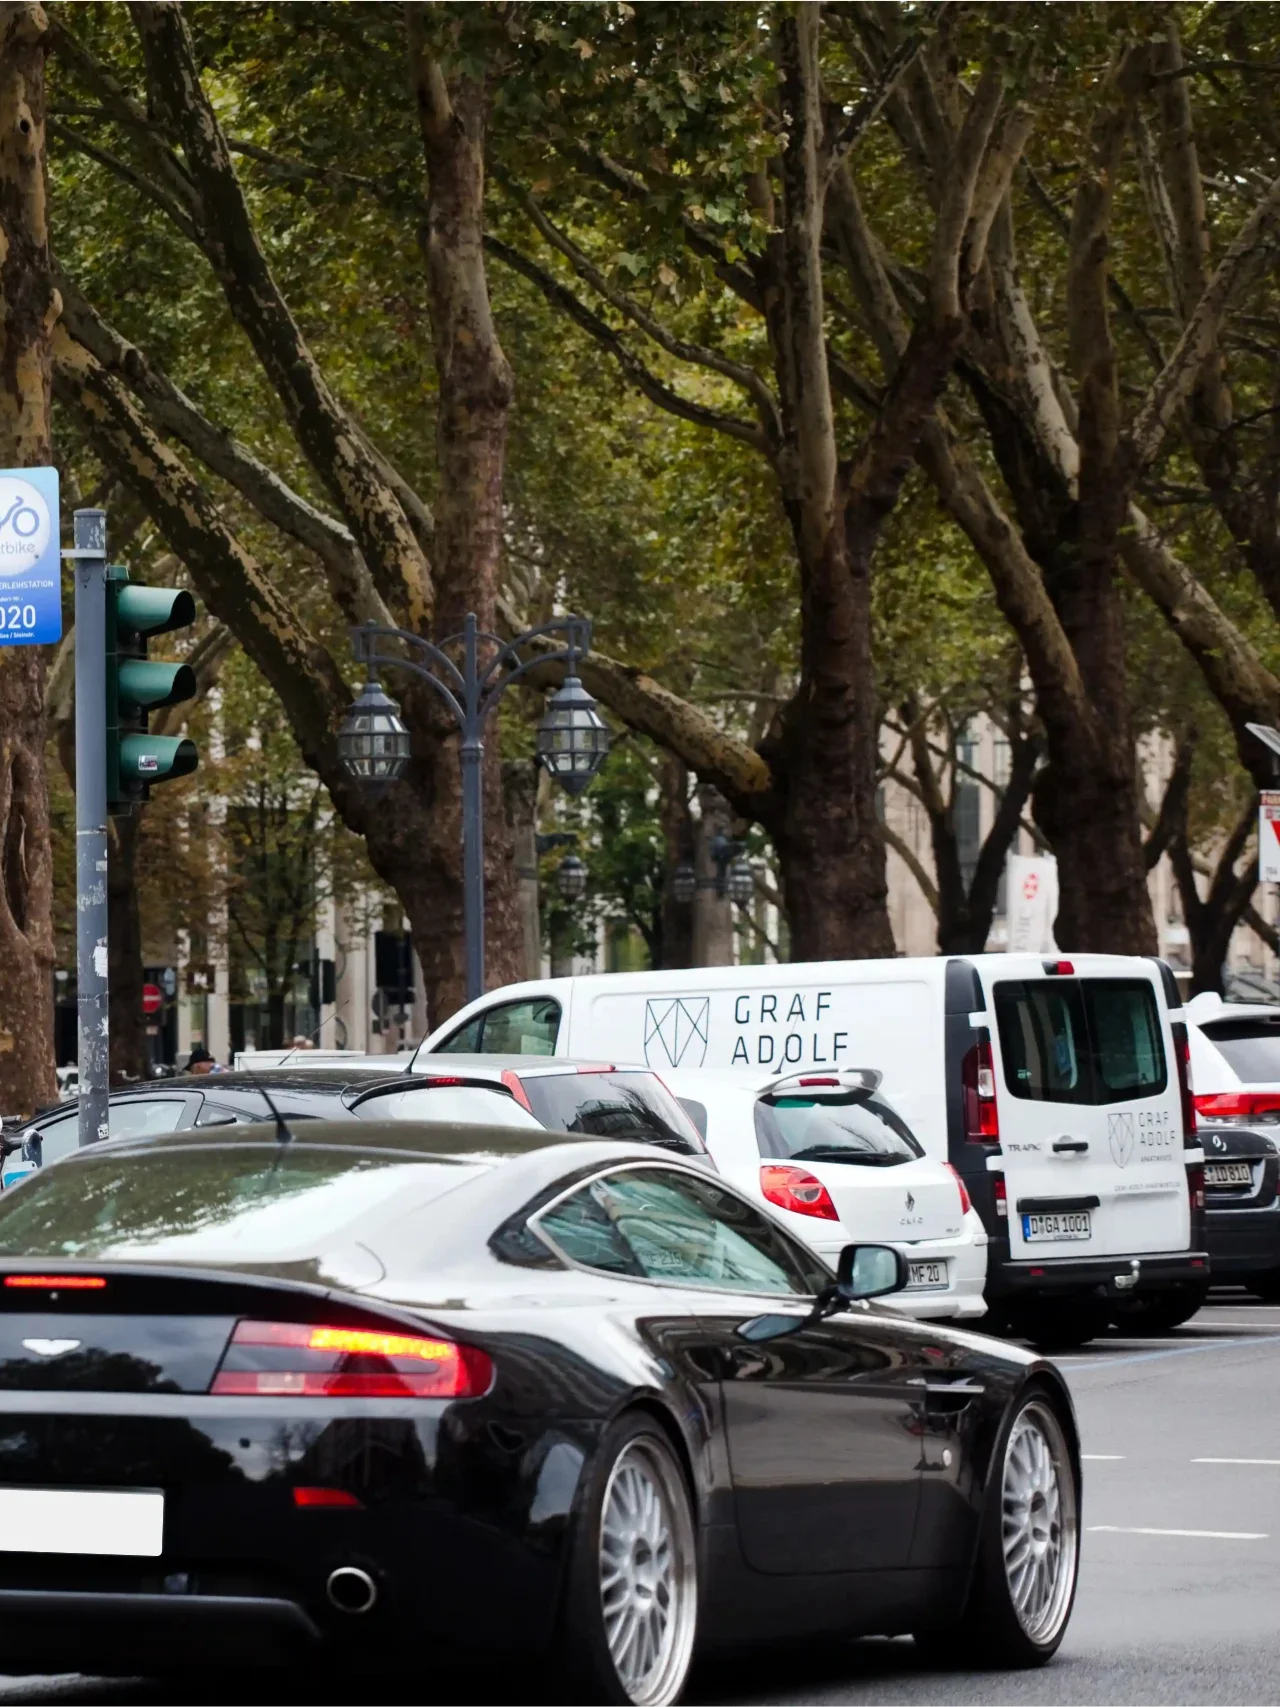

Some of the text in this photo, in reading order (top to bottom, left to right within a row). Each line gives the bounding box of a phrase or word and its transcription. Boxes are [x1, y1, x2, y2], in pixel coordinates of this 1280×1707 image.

[734, 992, 832, 1024] GRAF
[731, 1032, 848, 1065] ADOLF
[1139, 1111, 1168, 1127] GRAF
[1140, 1130, 1175, 1147] ADOLF
[1062, 1215, 1089, 1232] 1001
[927, 1265, 939, 1282] 20
